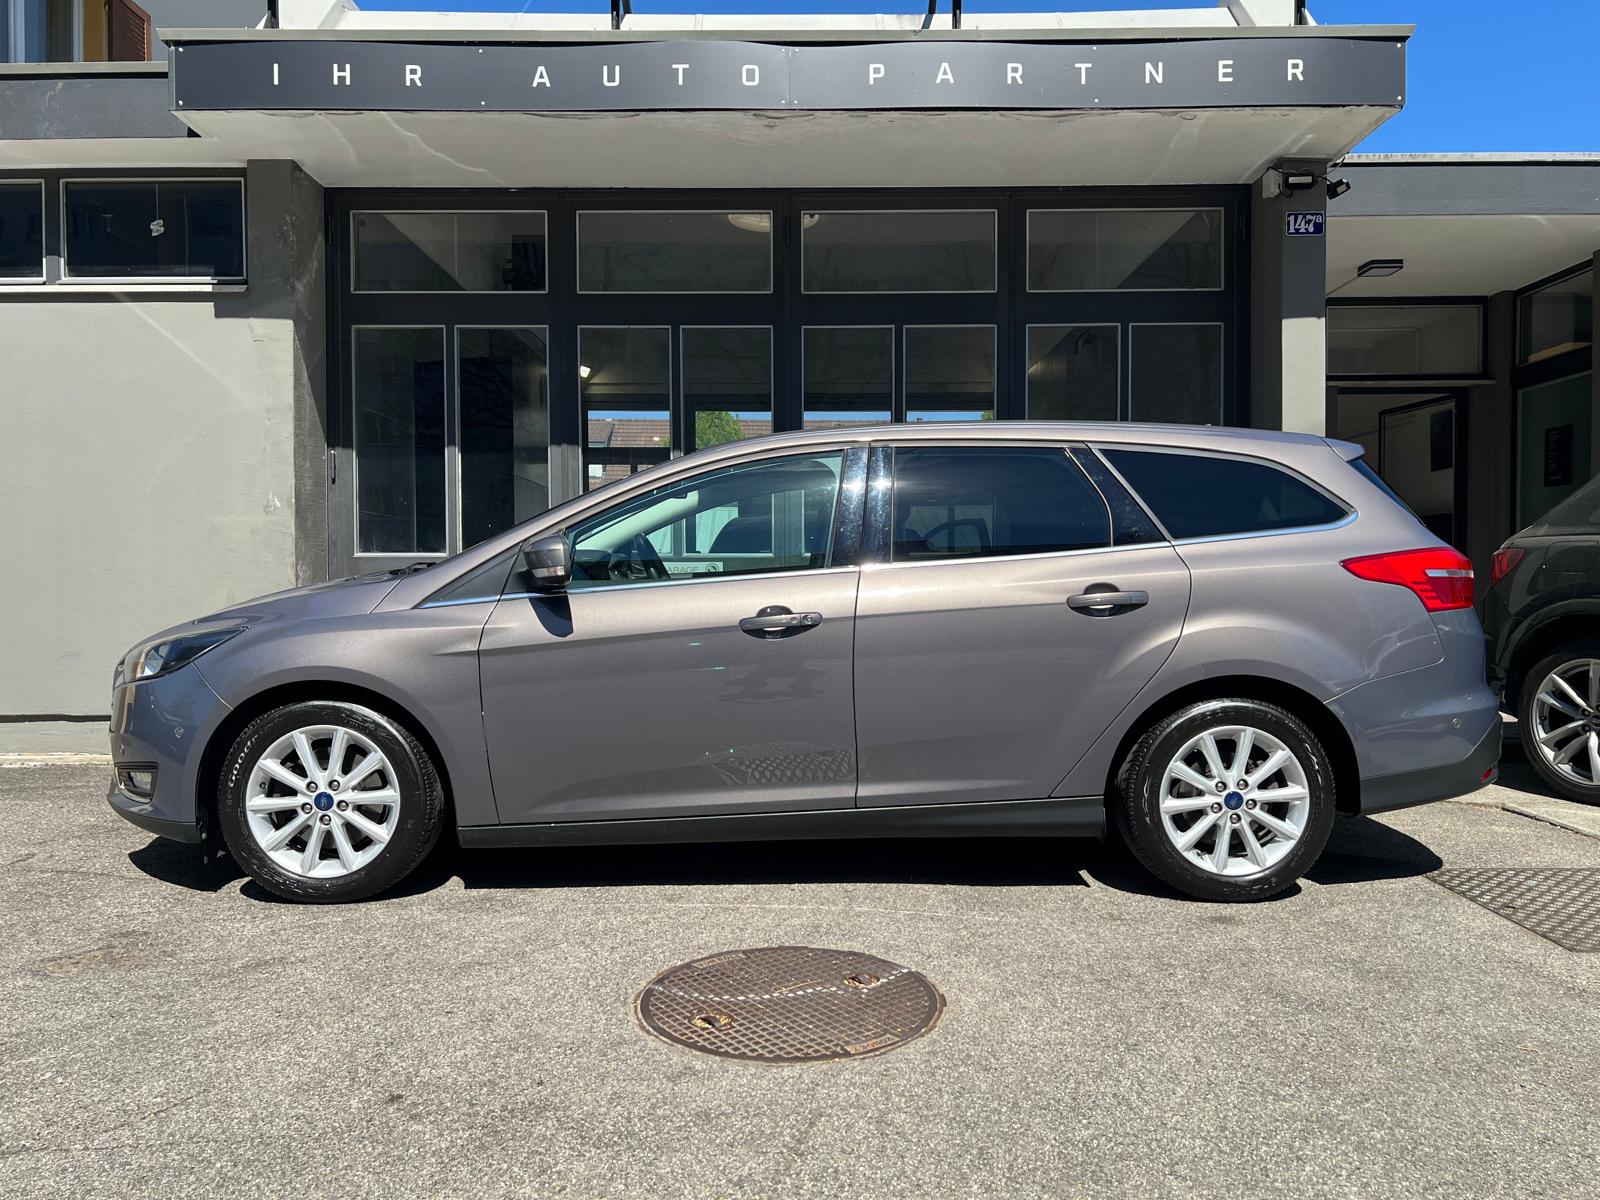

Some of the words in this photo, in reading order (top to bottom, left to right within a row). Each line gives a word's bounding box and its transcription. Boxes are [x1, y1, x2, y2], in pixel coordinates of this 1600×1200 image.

[273, 62, 423, 87] IHR
[531, 64, 760, 88] AUTO
[868, 59, 1305, 86] PARTNER
[1287, 214, 1322, 233] 147a
